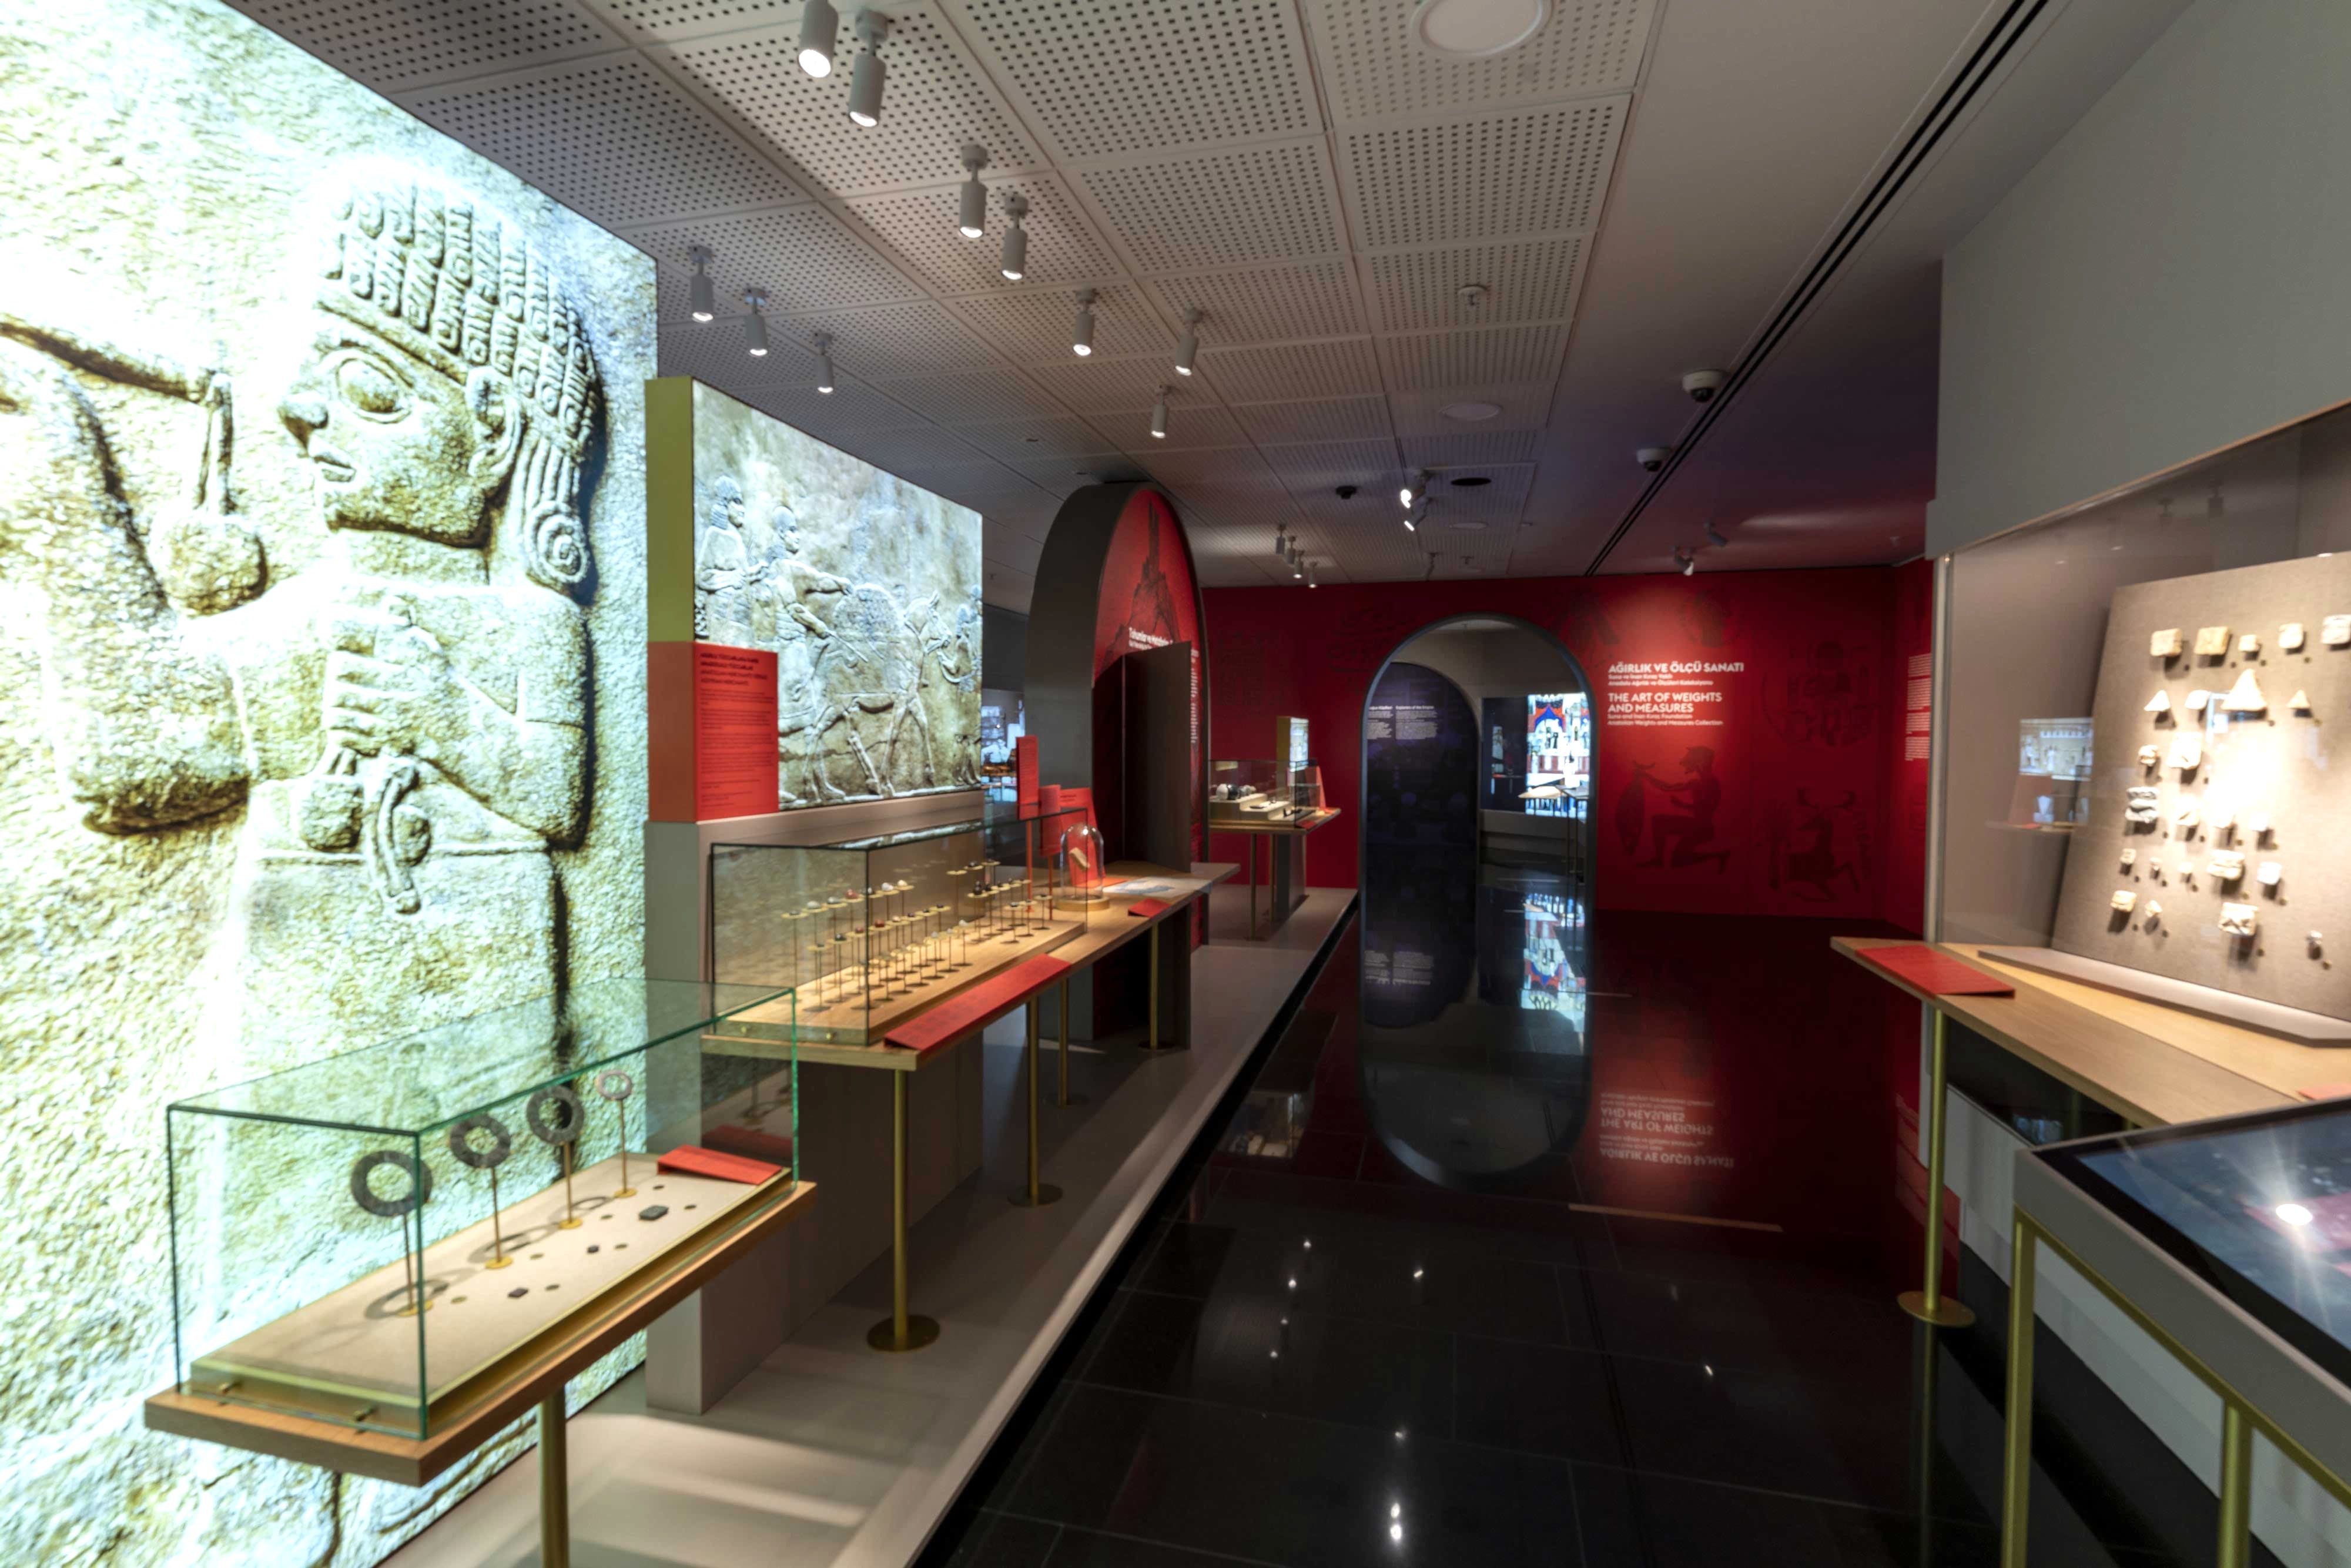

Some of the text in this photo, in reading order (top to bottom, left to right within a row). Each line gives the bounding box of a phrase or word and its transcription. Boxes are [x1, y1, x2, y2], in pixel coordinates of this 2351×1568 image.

[1608, 661, 1744, 674] AĞIRLIK VE ÖLÇÜ SANATI
[1608, 692, 1723, 702] THE ART OF WEIGHTS
[1608, 703, 1694, 713] AND MEASURES
